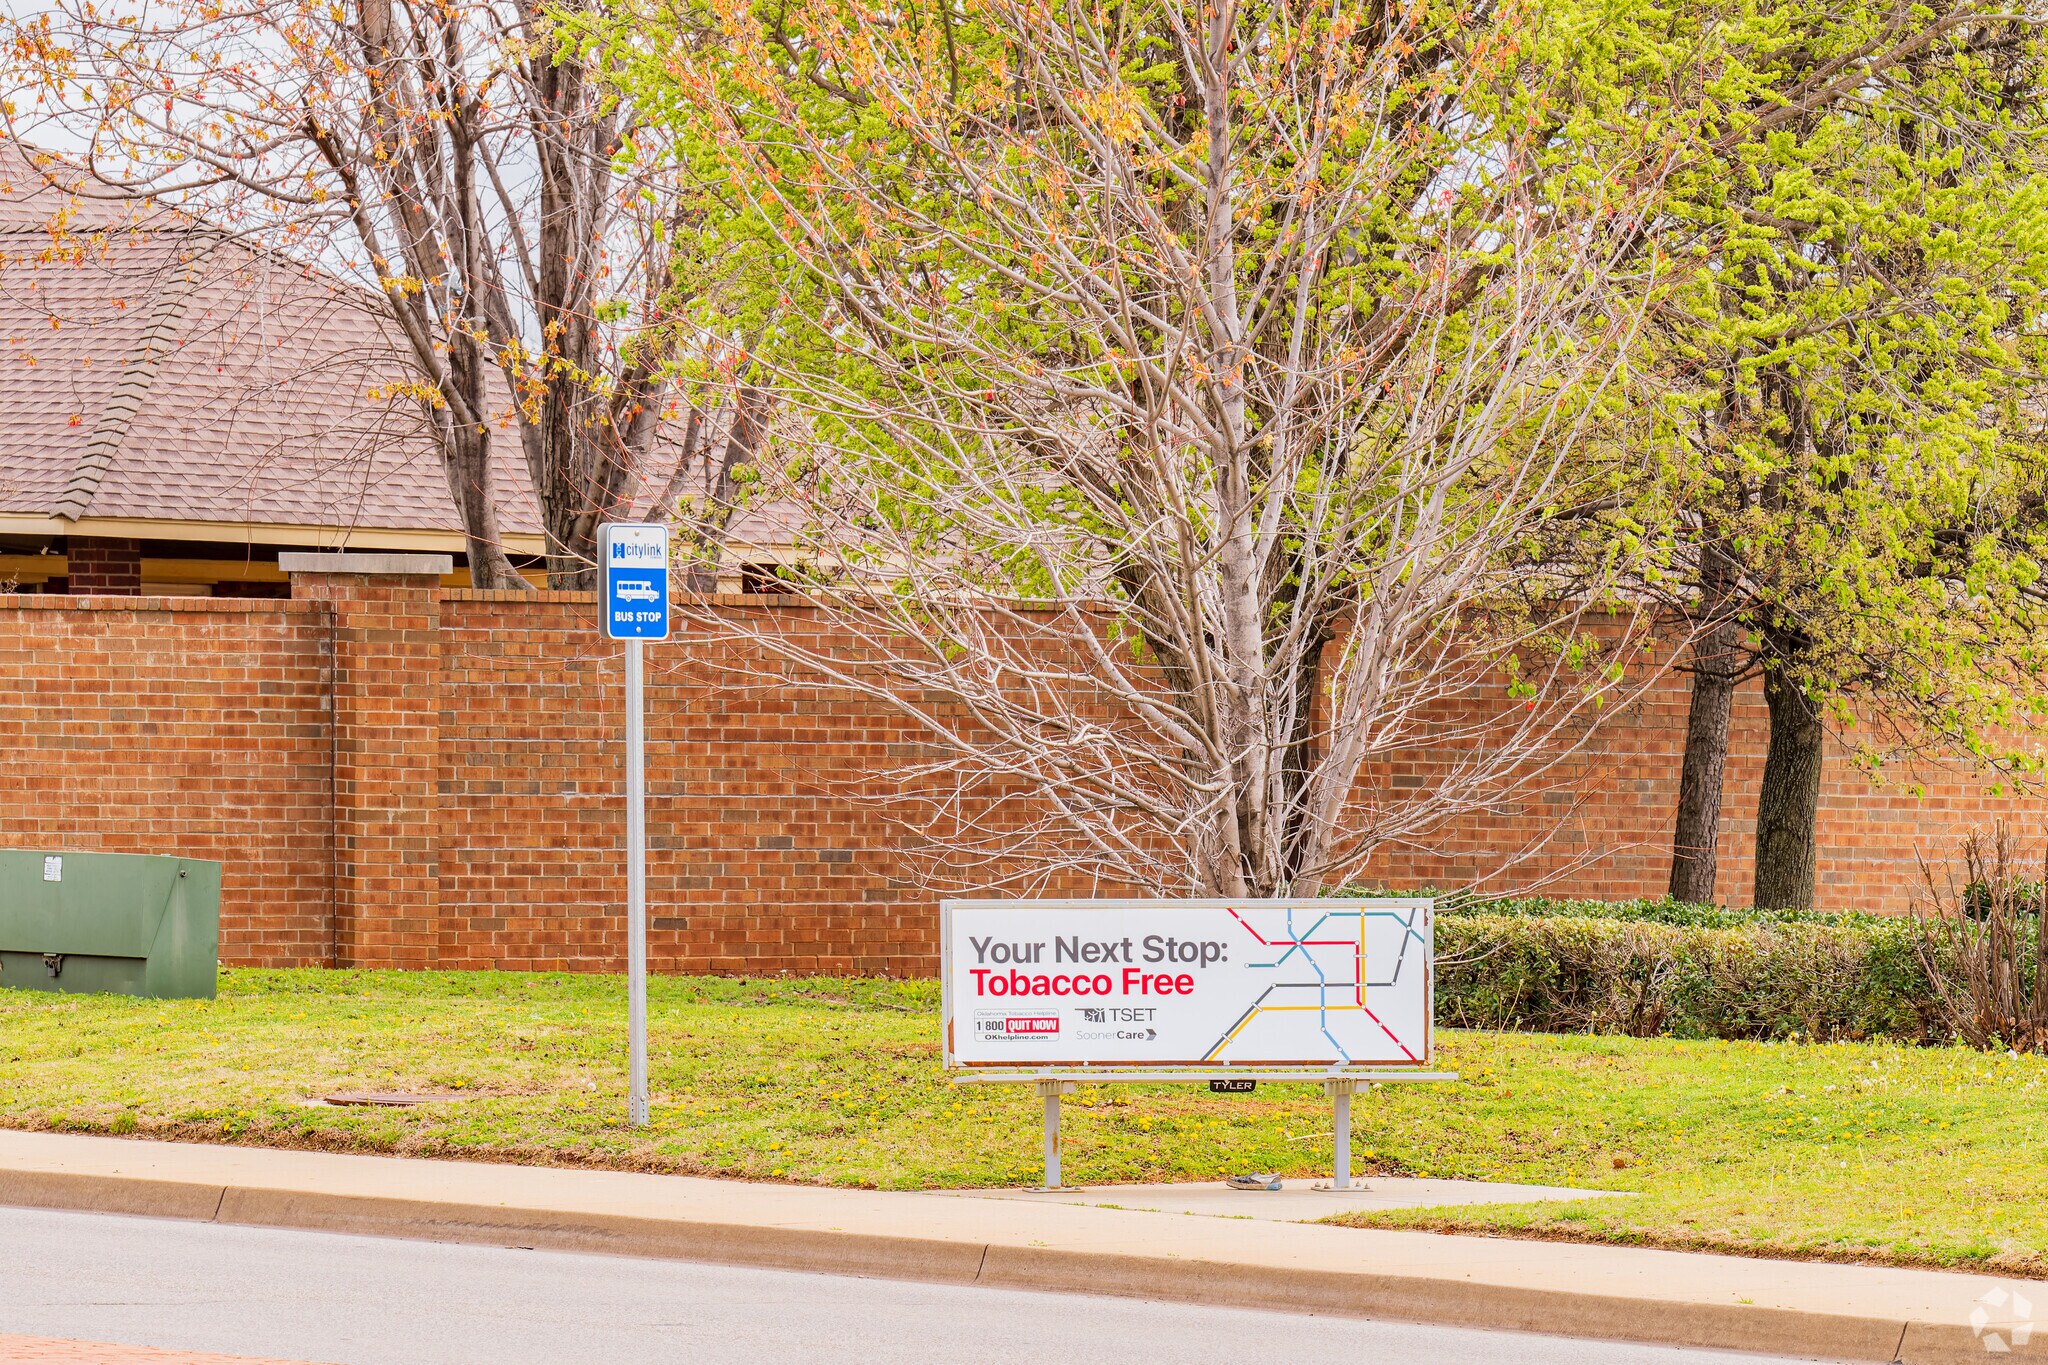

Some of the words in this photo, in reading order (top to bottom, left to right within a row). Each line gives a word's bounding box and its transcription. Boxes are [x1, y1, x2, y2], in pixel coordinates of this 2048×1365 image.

[626, 543, 661, 558] citylink
[615, 611, 634, 622] BUS
[636, 611, 662, 622] STOP
[968, 936, 1046, 964] Your
[1055, 936, 1133, 964] Next
[1142, 935, 1228, 968] Stop:
[969, 968, 1113, 996] Tobacco
[1122, 967, 1195, 995] Free
[1109, 1008, 1157, 1022] TSET
[977, 1020, 981, 1031] 1
[985, 1020, 1004, 1031] 800
[1008, 1019, 1031, 1032] QUIT
[1032, 1019, 1057, 1031] NOW
[1076, 1030, 1145, 1040] SoonerCare
[1213, 1081, 1252, 1090] TYLER
